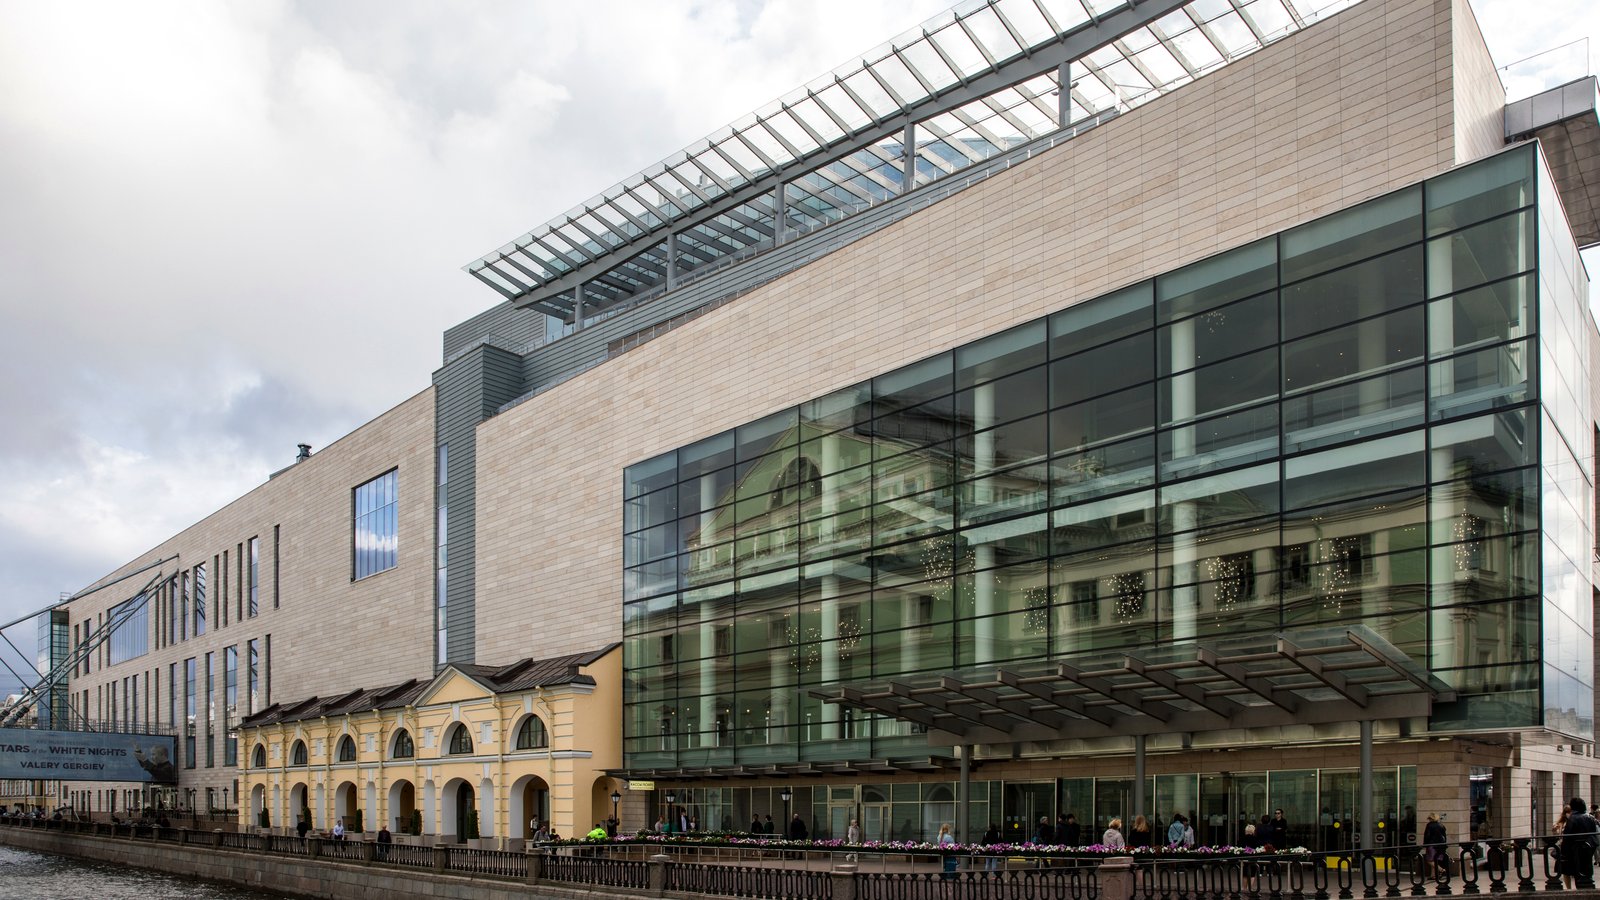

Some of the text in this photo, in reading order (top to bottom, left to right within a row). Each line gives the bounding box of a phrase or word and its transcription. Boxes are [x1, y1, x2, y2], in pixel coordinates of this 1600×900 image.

[49, 746, 86, 755] WHITE
[88, 748, 127, 757] NIGHTS
[20, 761, 60, 769] VALERY
